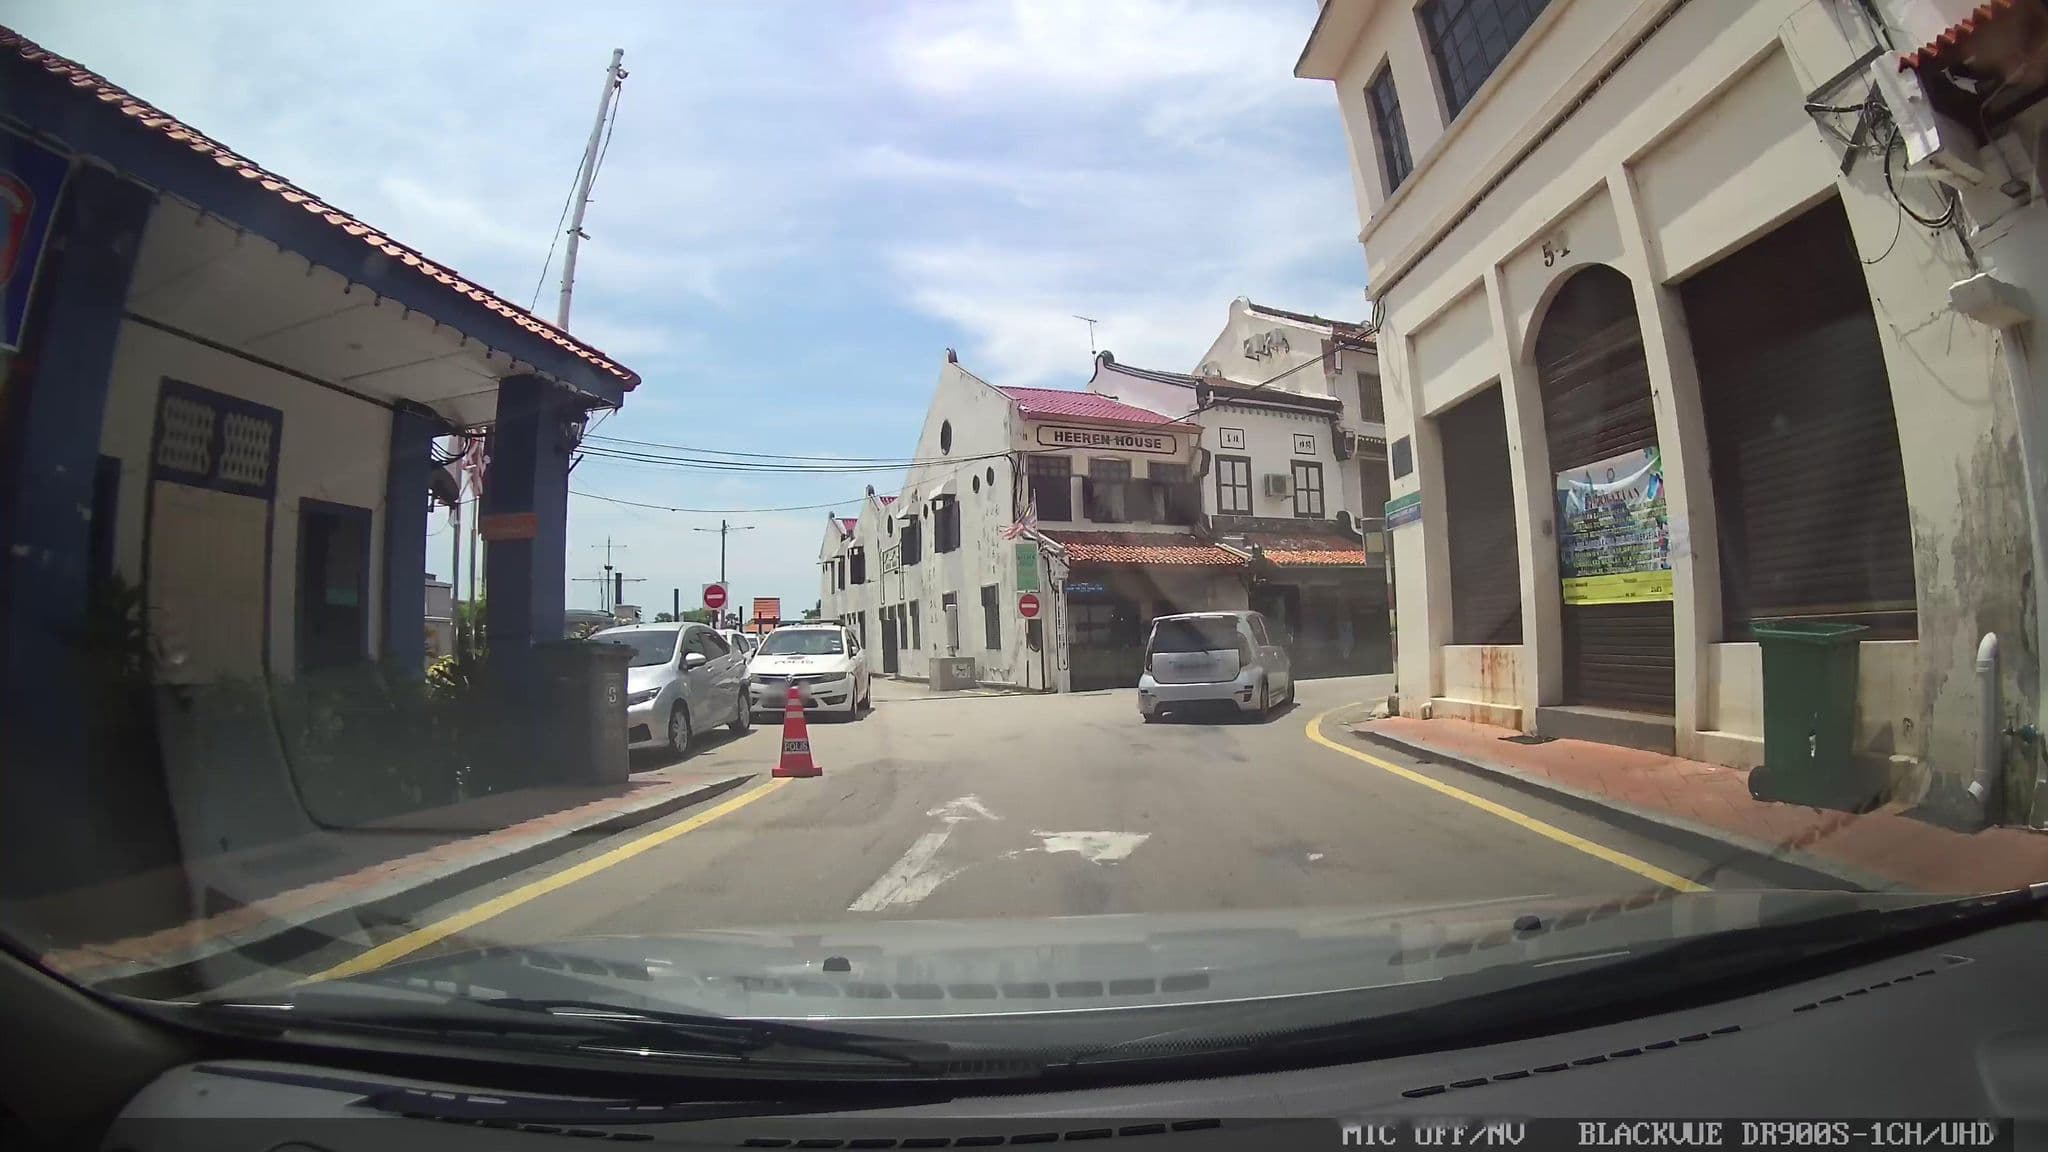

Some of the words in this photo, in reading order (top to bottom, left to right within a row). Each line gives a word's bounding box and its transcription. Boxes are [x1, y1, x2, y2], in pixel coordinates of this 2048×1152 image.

[1054, 430, 1111, 445] HEEREN
[1115, 435, 1162, 449] HOUSE
[784, 741, 809, 752] POLIS
